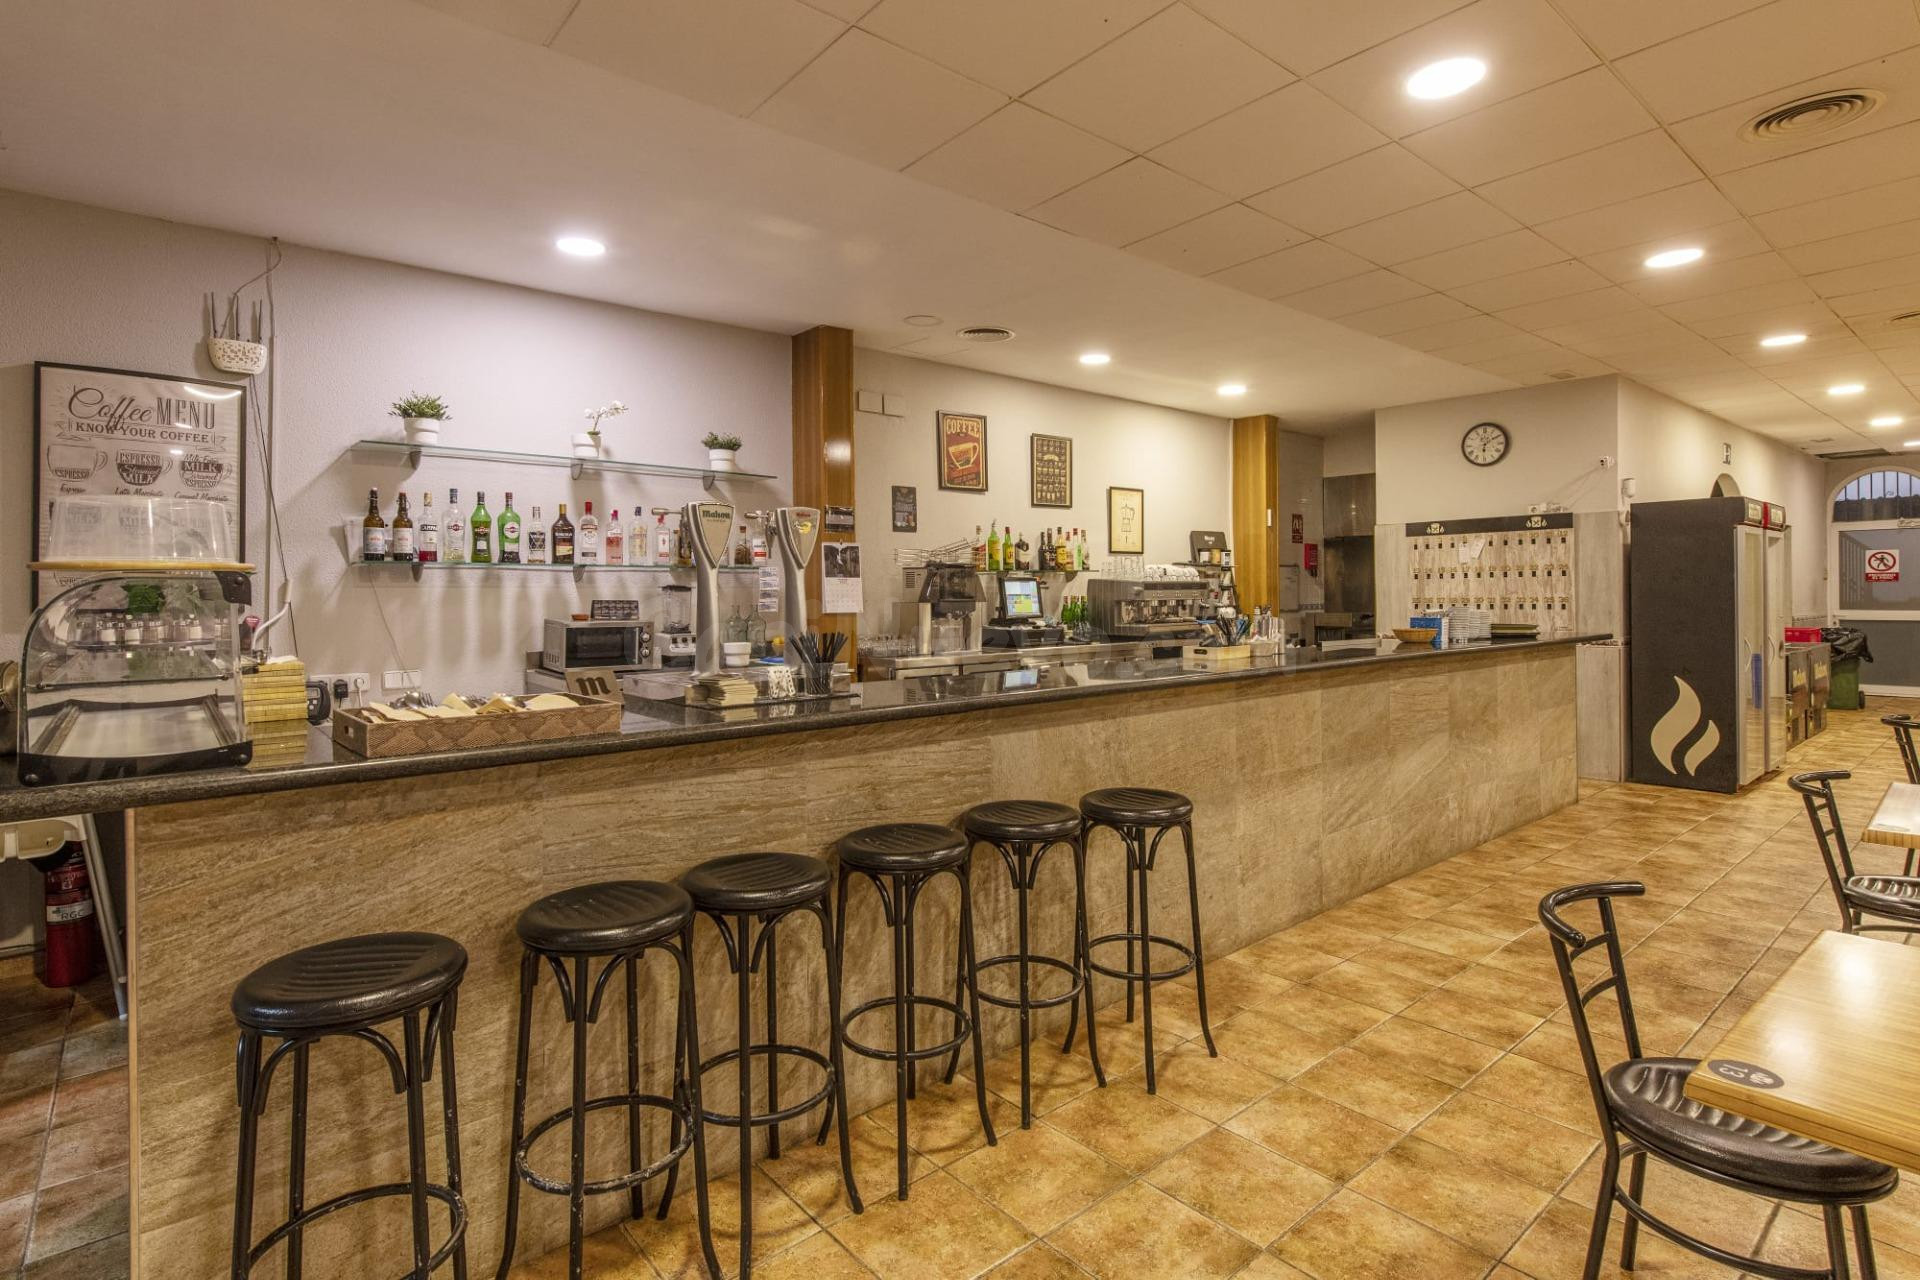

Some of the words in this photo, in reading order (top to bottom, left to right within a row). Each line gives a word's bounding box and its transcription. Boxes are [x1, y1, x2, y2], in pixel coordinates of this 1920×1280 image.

[68, 385, 152, 430] Coffee
[156, 396, 215, 430] MENU
[75, 421, 115, 434] KNOW
[121, 425, 156, 439] YOUR
[159, 430, 209, 443] COFFEE
[946, 418, 980, 438] COFFEE
[184, 461, 217, 472] MILK
[702, 509, 731, 519] Mahou
